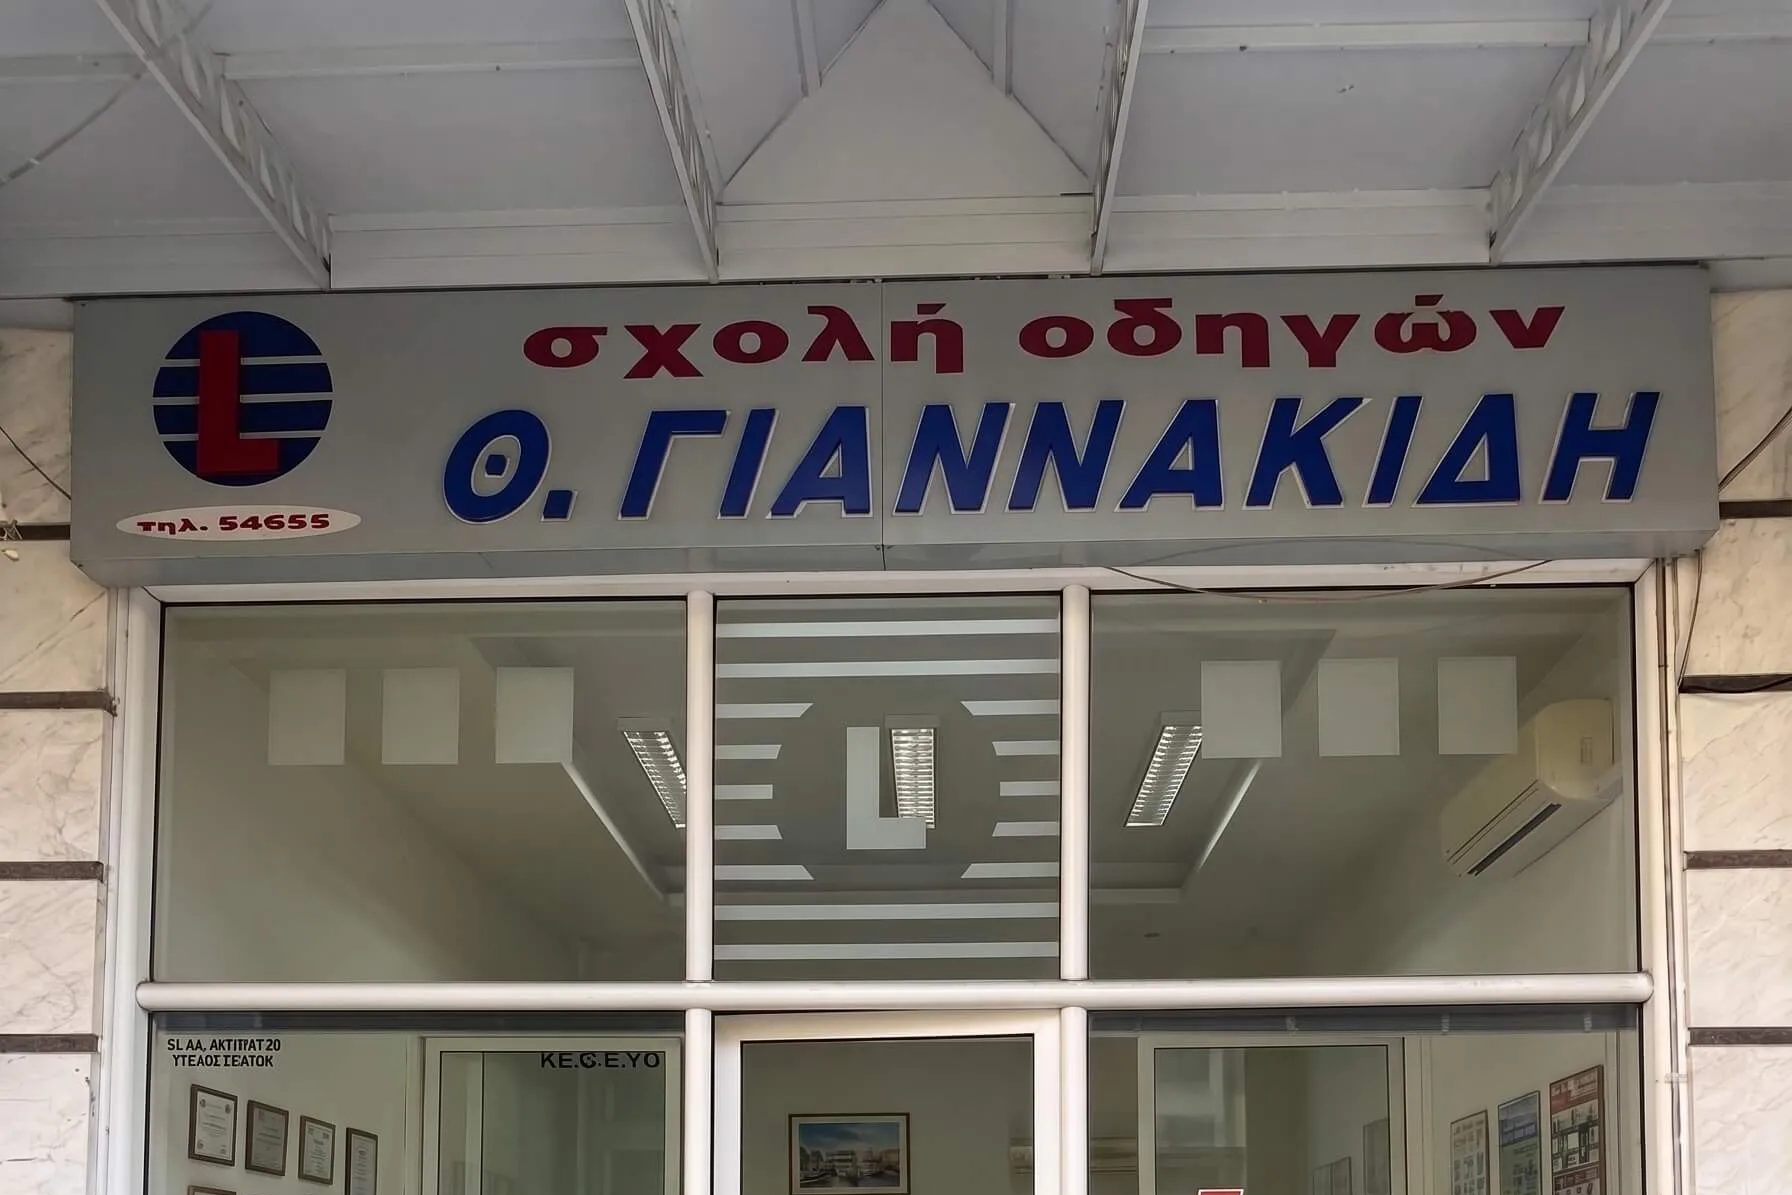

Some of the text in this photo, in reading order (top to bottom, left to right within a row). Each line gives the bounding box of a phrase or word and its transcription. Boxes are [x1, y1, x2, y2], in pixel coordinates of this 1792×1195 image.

[523, 294, 1566, 379] σχολή οδηγών
[136, 513, 331, 535] τηλ. 54655
